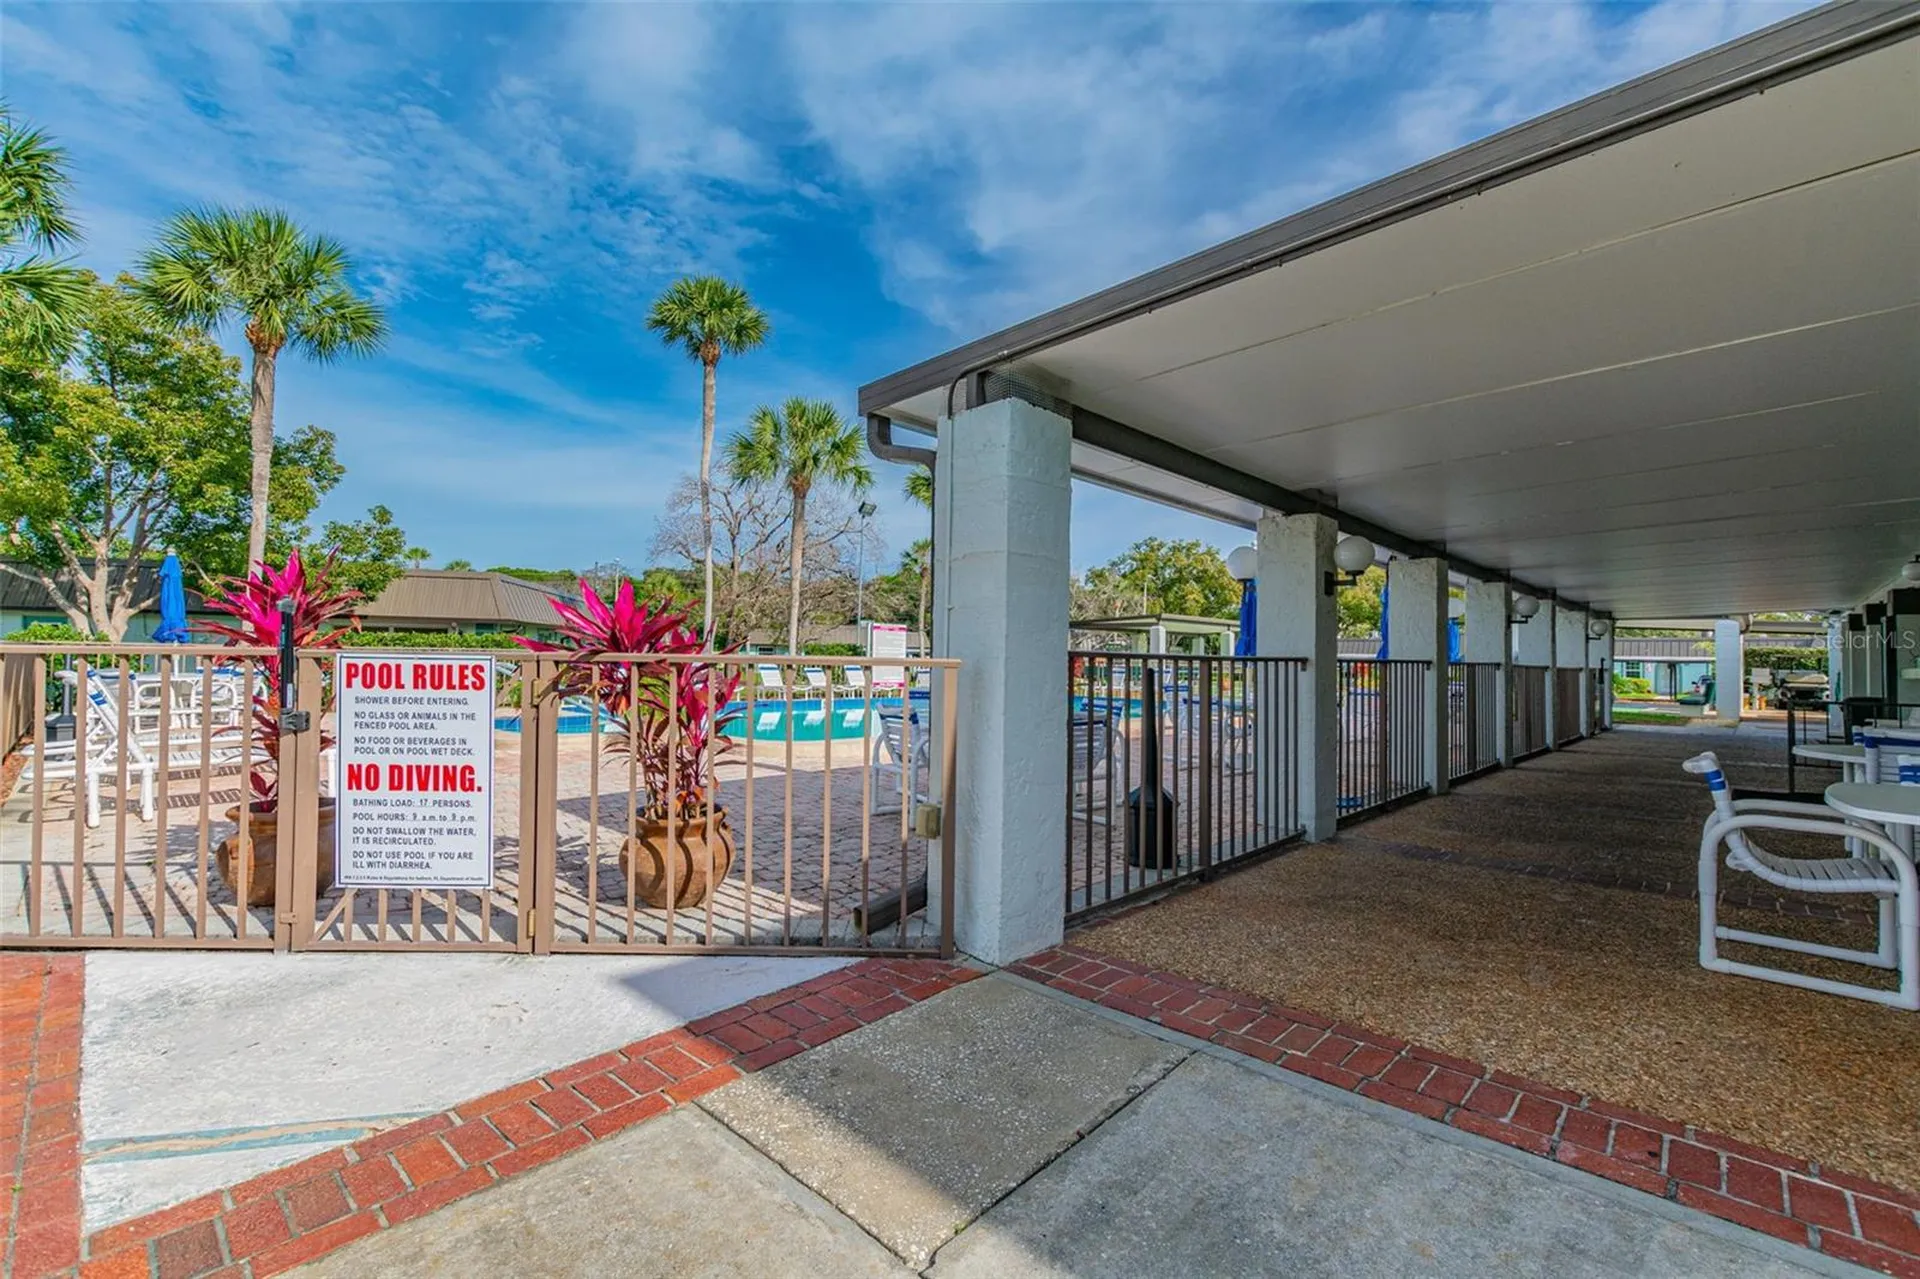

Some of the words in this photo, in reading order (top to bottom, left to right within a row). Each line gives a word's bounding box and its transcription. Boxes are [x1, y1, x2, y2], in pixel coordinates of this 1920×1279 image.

[345, 662, 405, 690] POOL
[412, 663, 486, 691] RULES
[355, 696, 390, 704] SHOWER
[392, 697, 424, 705] BEFORE
[427, 697, 469, 706] ENTERING.
[368, 712, 395, 720] GLASS
[398, 712, 409, 720] OR
[411, 712, 447, 720] ANIMALS
[461, 713, 476, 721] THE
[355, 721, 386, 729] FENCED
[389, 722, 410, 730] POOL
[413, 722, 437, 730] AREA.
[354, 737, 366, 745] NO
[368, 737, 390, 745] FOOD
[393, 737, 405, 745] OR
[407, 737, 456, 746] BEVERAGES
[459, 738, 467, 746] IN
[378, 747, 390, 755] OR
[393, 747, 404, 755] ON
[407, 747, 429, 755] POOL
[431, 748, 448, 756] WET
[450, 748, 475, 756] DECK.
[347, 763, 381, 791] NO
[388, 764, 482, 792] DIVING.
[353, 799, 388, 807] BATHING
[390, 799, 415, 807] LOAD:
[420, 799, 429, 807] 17
[433, 800, 472, 808] PERSONS.
[377, 813, 408, 821] HOURS:
[367, 827, 383, 835] NOT
[385, 827, 426, 835] SWALLOW
[446, 828, 477, 837] WATER,
[362, 837, 370, 845] IS
[372, 837, 436, 846] RECIRCULATED.
[353, 851, 364, 859] DO
[366, 851, 383, 859] NOT
[385, 851, 401, 859] USE
[404, 852, 425, 860] POOL
[428, 852, 436, 860] IF
[438, 852, 455, 860] YOU
[457, 852, 473, 860] ARE
[352, 861, 364, 869] ILL
[366, 861, 387, 869] WITH
[389, 861, 432, 870] DIARRHEA.
